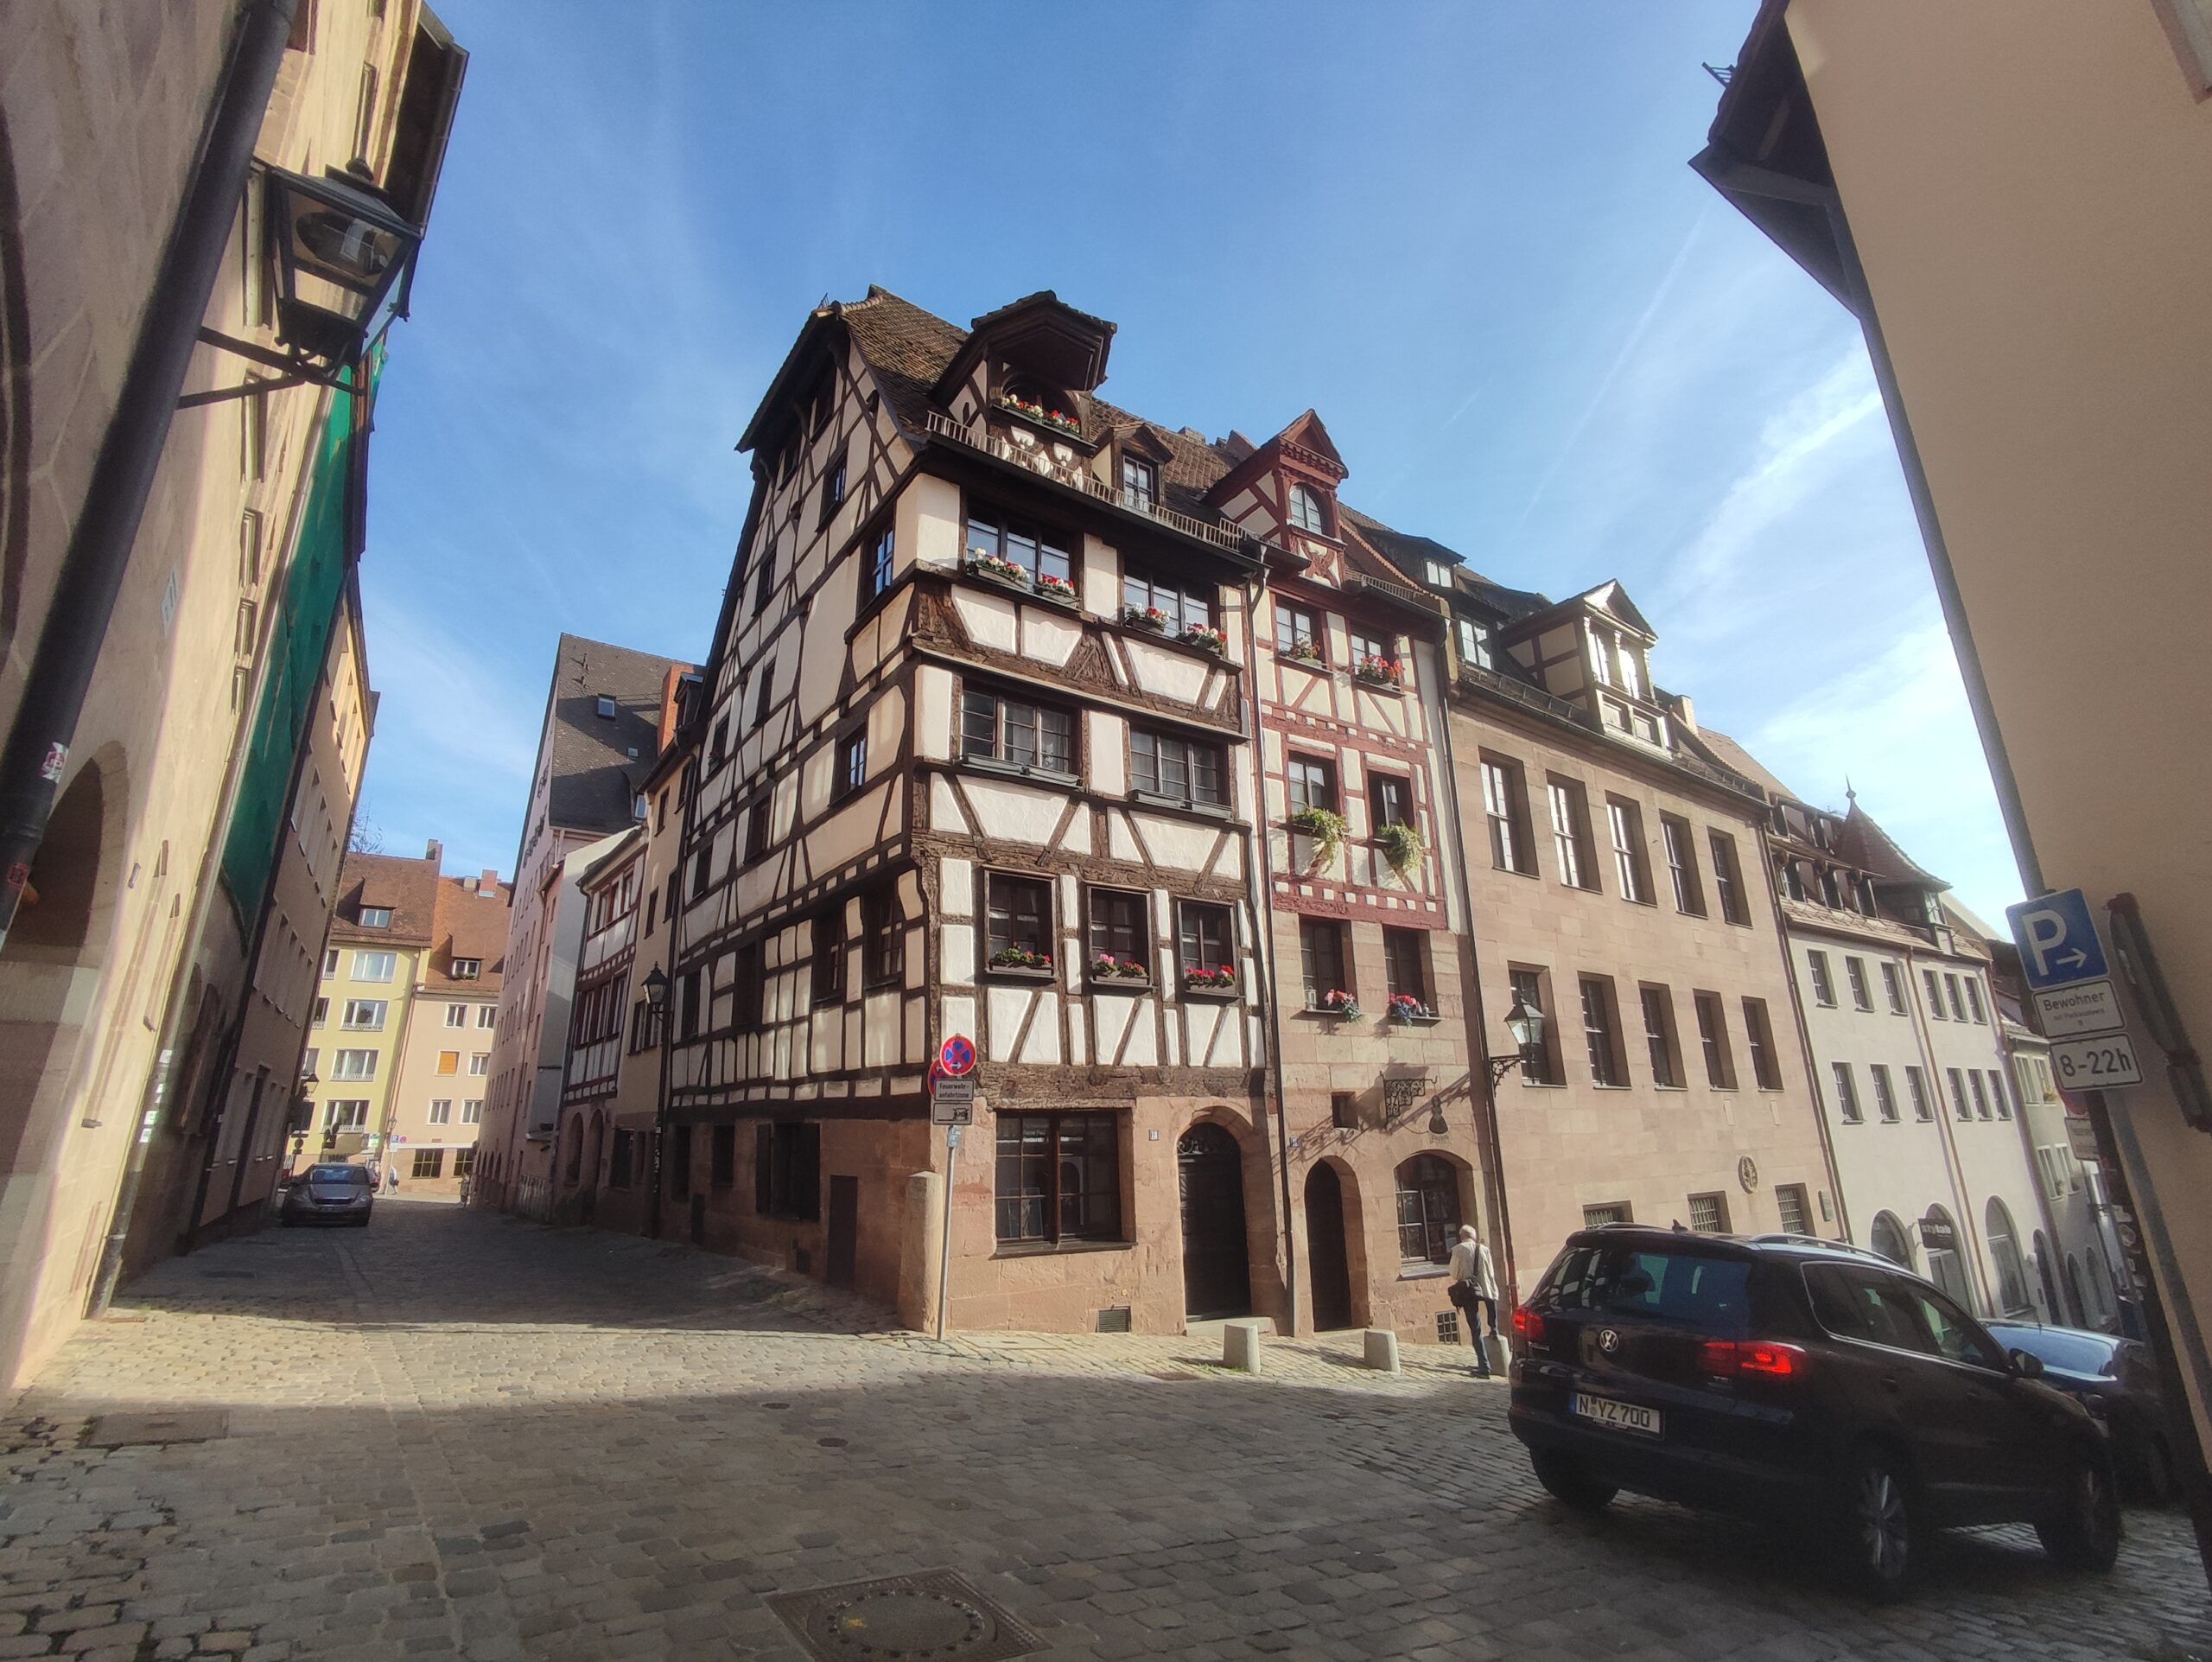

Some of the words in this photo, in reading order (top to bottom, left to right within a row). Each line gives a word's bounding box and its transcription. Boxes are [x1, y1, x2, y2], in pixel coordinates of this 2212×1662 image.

[2021, 908, 2068, 977] P
[2043, 992, 2106, 1011] Bewohner
[1579, 1396, 1589, 1414] N
[1598, 1399, 1617, 1421] YZ
[1620, 1404, 1650, 1429] 700
